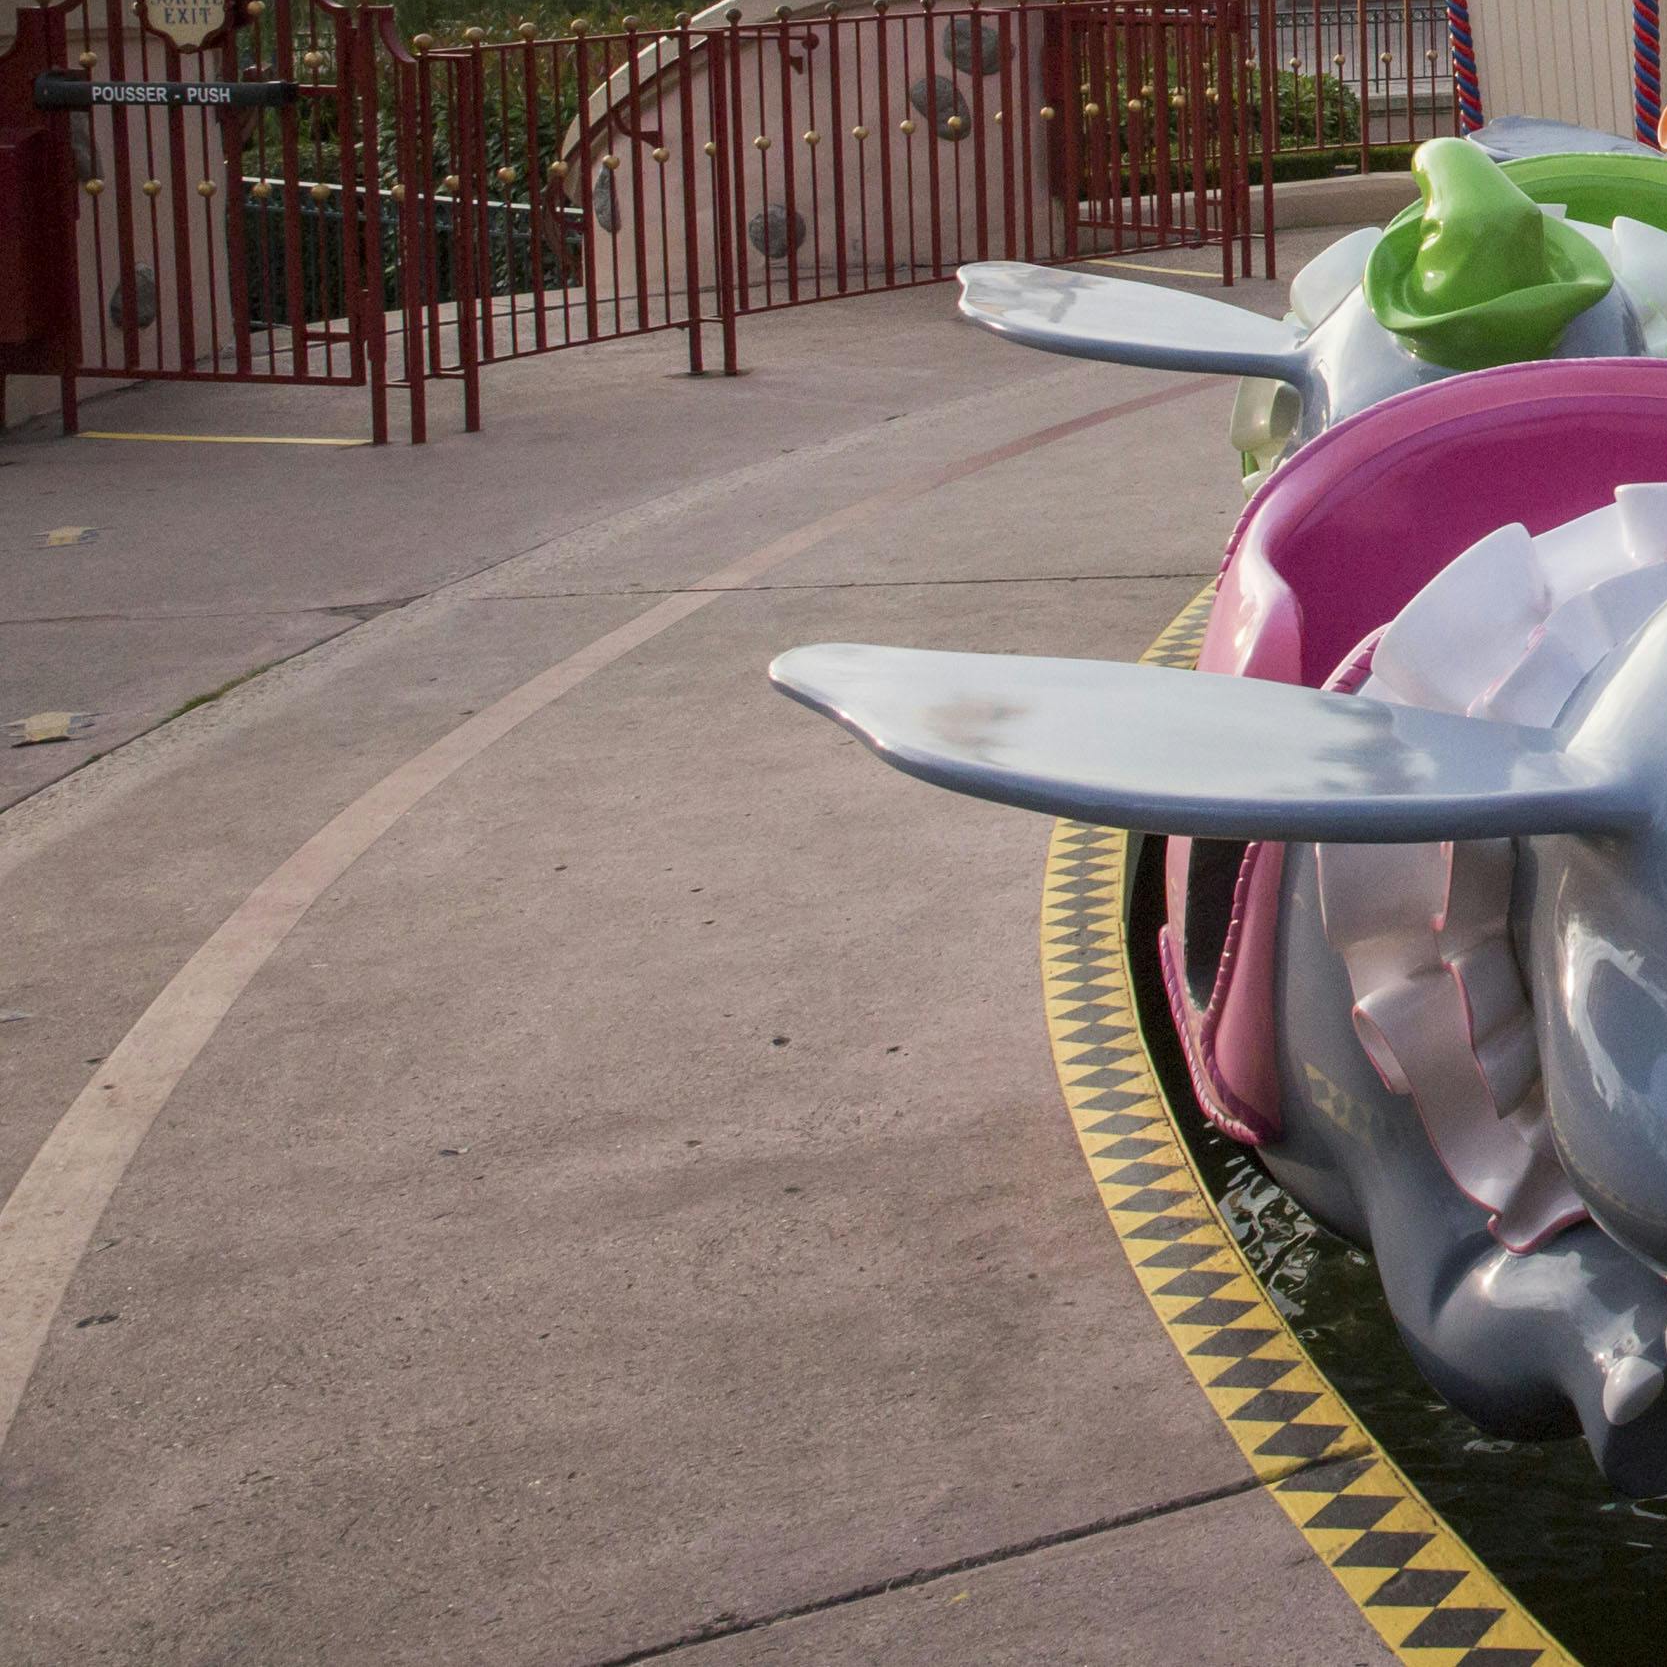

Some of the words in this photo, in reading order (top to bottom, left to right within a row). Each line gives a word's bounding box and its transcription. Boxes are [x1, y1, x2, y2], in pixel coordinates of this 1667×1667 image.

[164, 7, 211, 24] EXIT
[92, 86, 168, 102] POUSSER
[187, 87, 231, 102] PUSH
